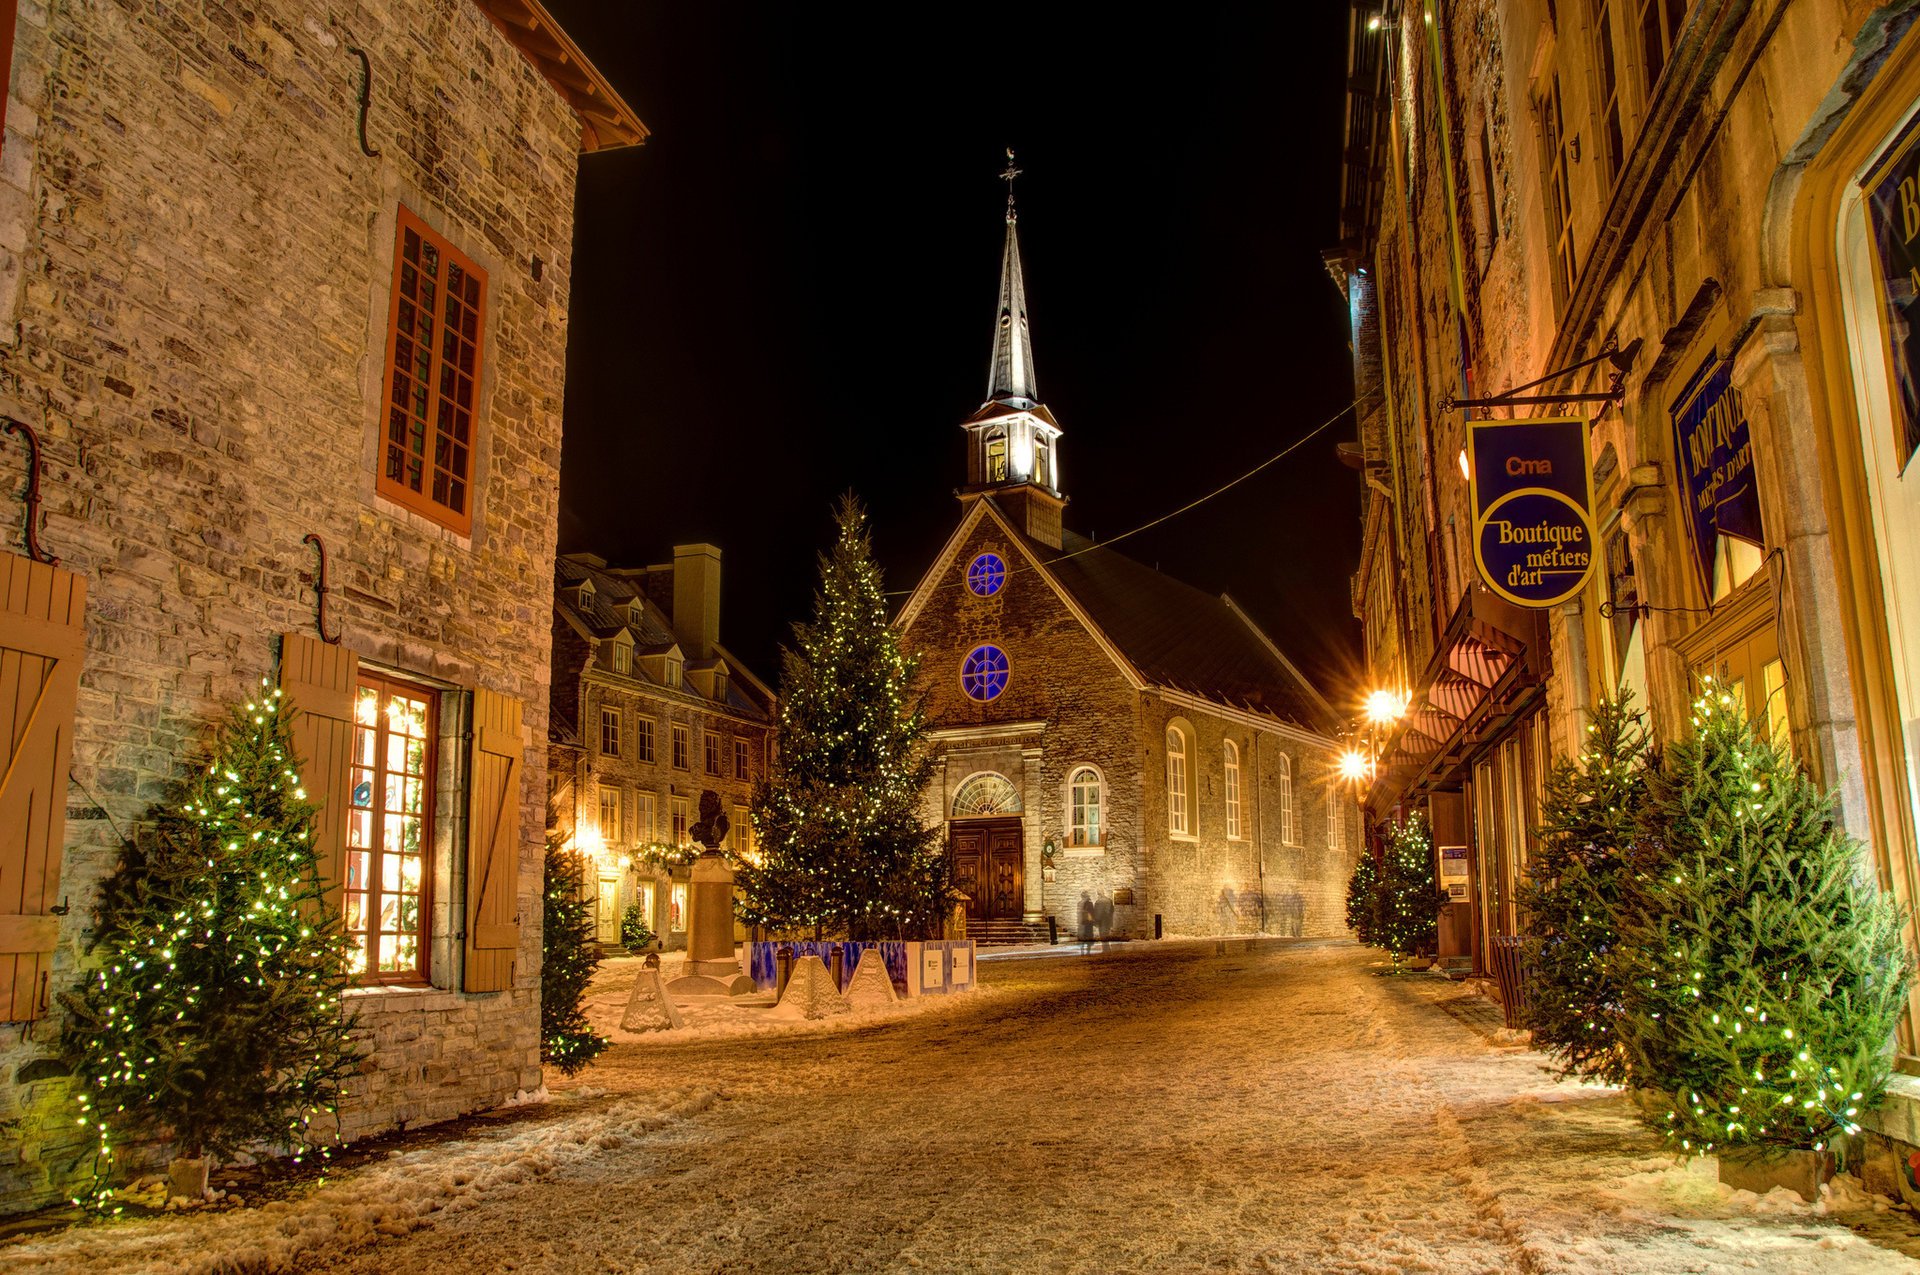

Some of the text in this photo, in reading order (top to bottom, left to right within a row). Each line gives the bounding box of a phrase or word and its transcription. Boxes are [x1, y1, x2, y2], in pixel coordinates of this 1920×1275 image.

[1499, 520, 1583, 550] Boutique
[1527, 549, 1589, 567] métiers
[1508, 564, 1543, 587] d'art
